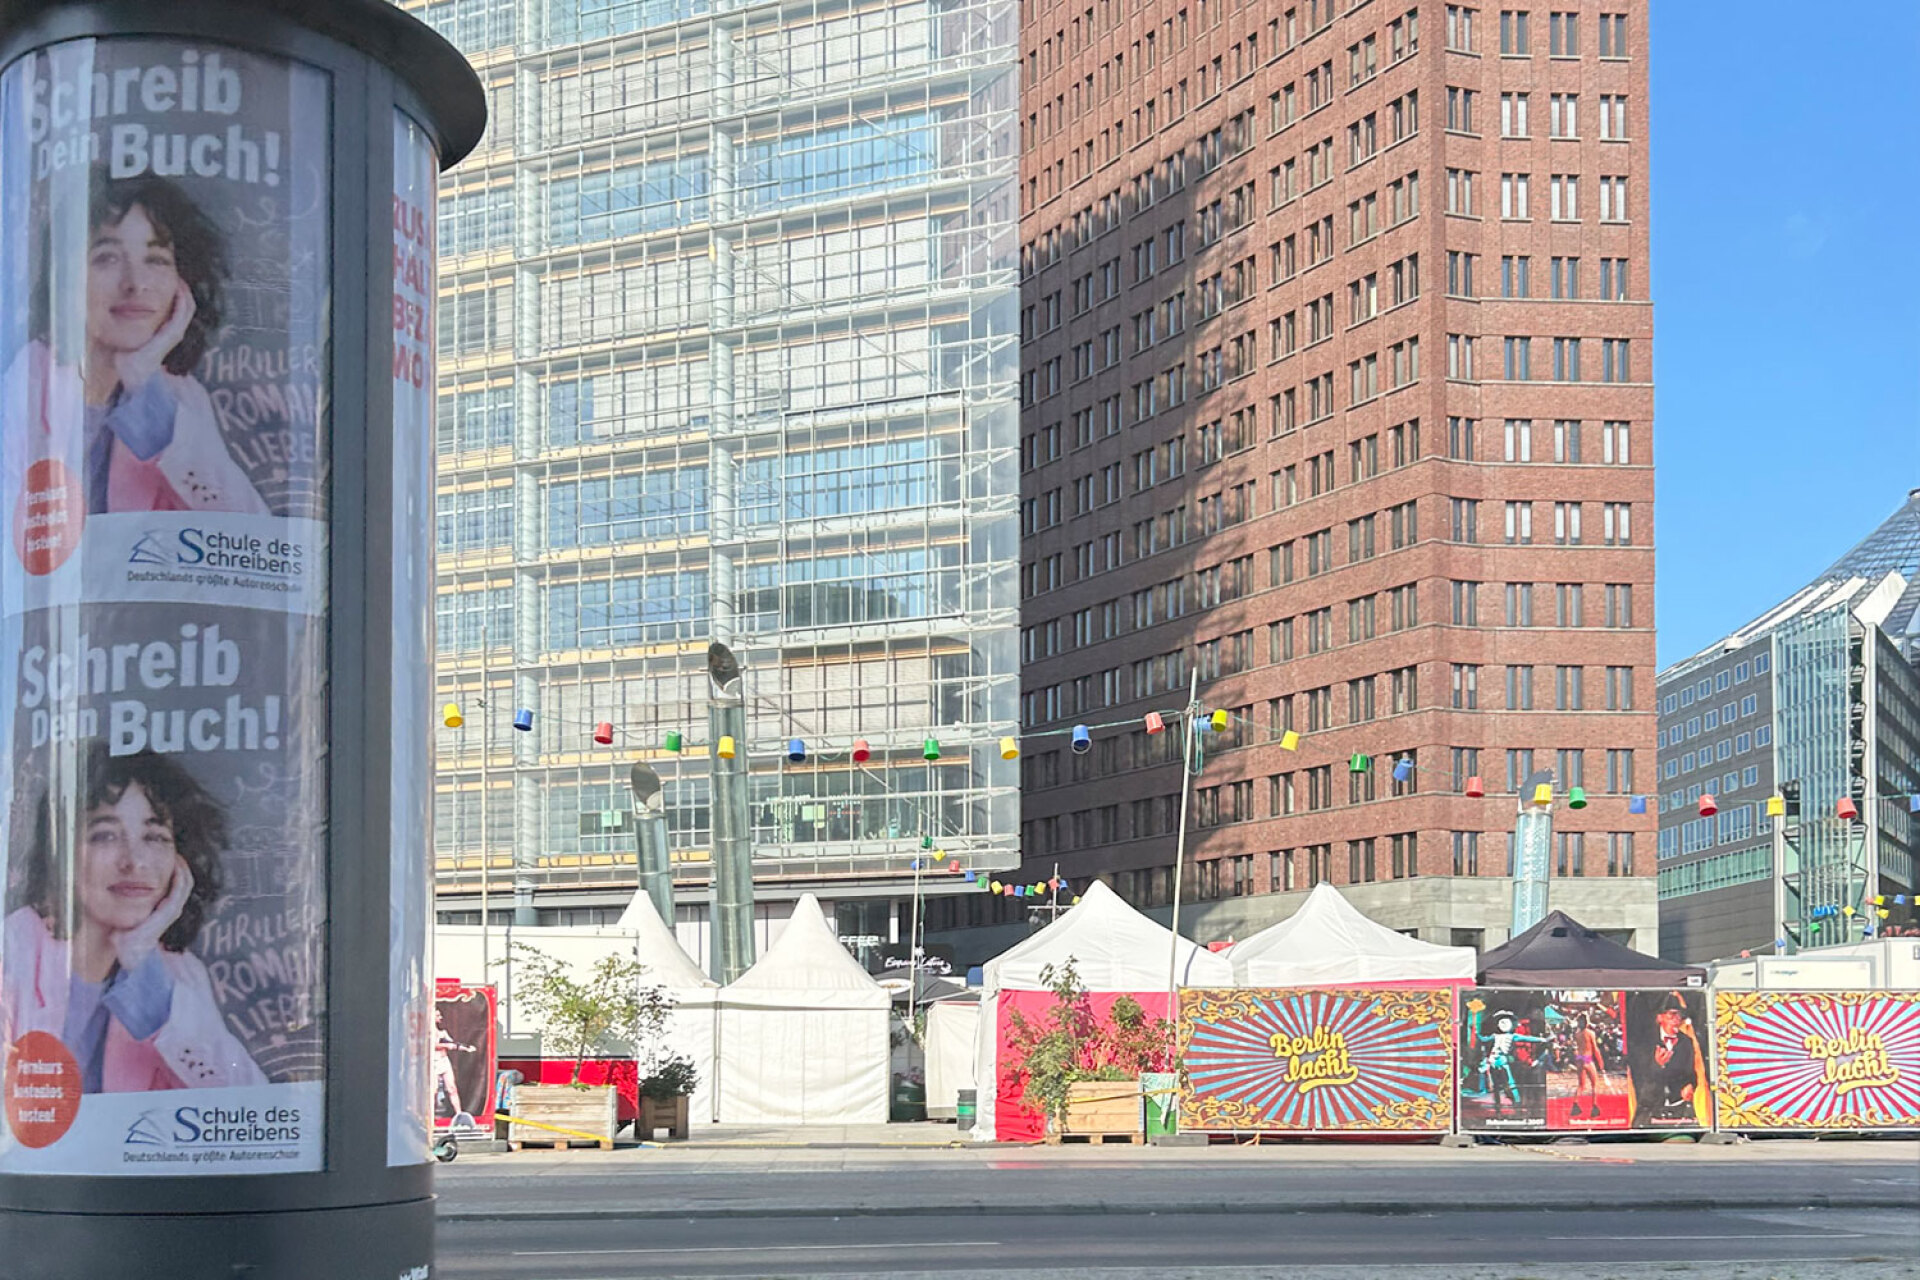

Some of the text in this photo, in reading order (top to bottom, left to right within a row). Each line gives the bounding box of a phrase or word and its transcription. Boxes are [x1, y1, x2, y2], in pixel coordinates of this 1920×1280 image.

[31, 50, 242, 142] Schreib
[37, 123, 280, 187] Dein Buch!
[204, 344, 320, 382] THRILLER
[178, 528, 303, 558] Schule des
[22, 623, 241, 708] Schreib
[32, 694, 280, 757] Dein Buch!
[1269, 1024, 1347, 1057] Berlin
[1804, 1027, 1885, 1059] Berlin
[1284, 1049, 1359, 1093] lacht
[1820, 1050, 1900, 1095] lacht
[174, 1107, 300, 1135] Schule des
[123, 1151, 190, 1163] Deutschlands
[191, 1151, 226, 1165] größte
